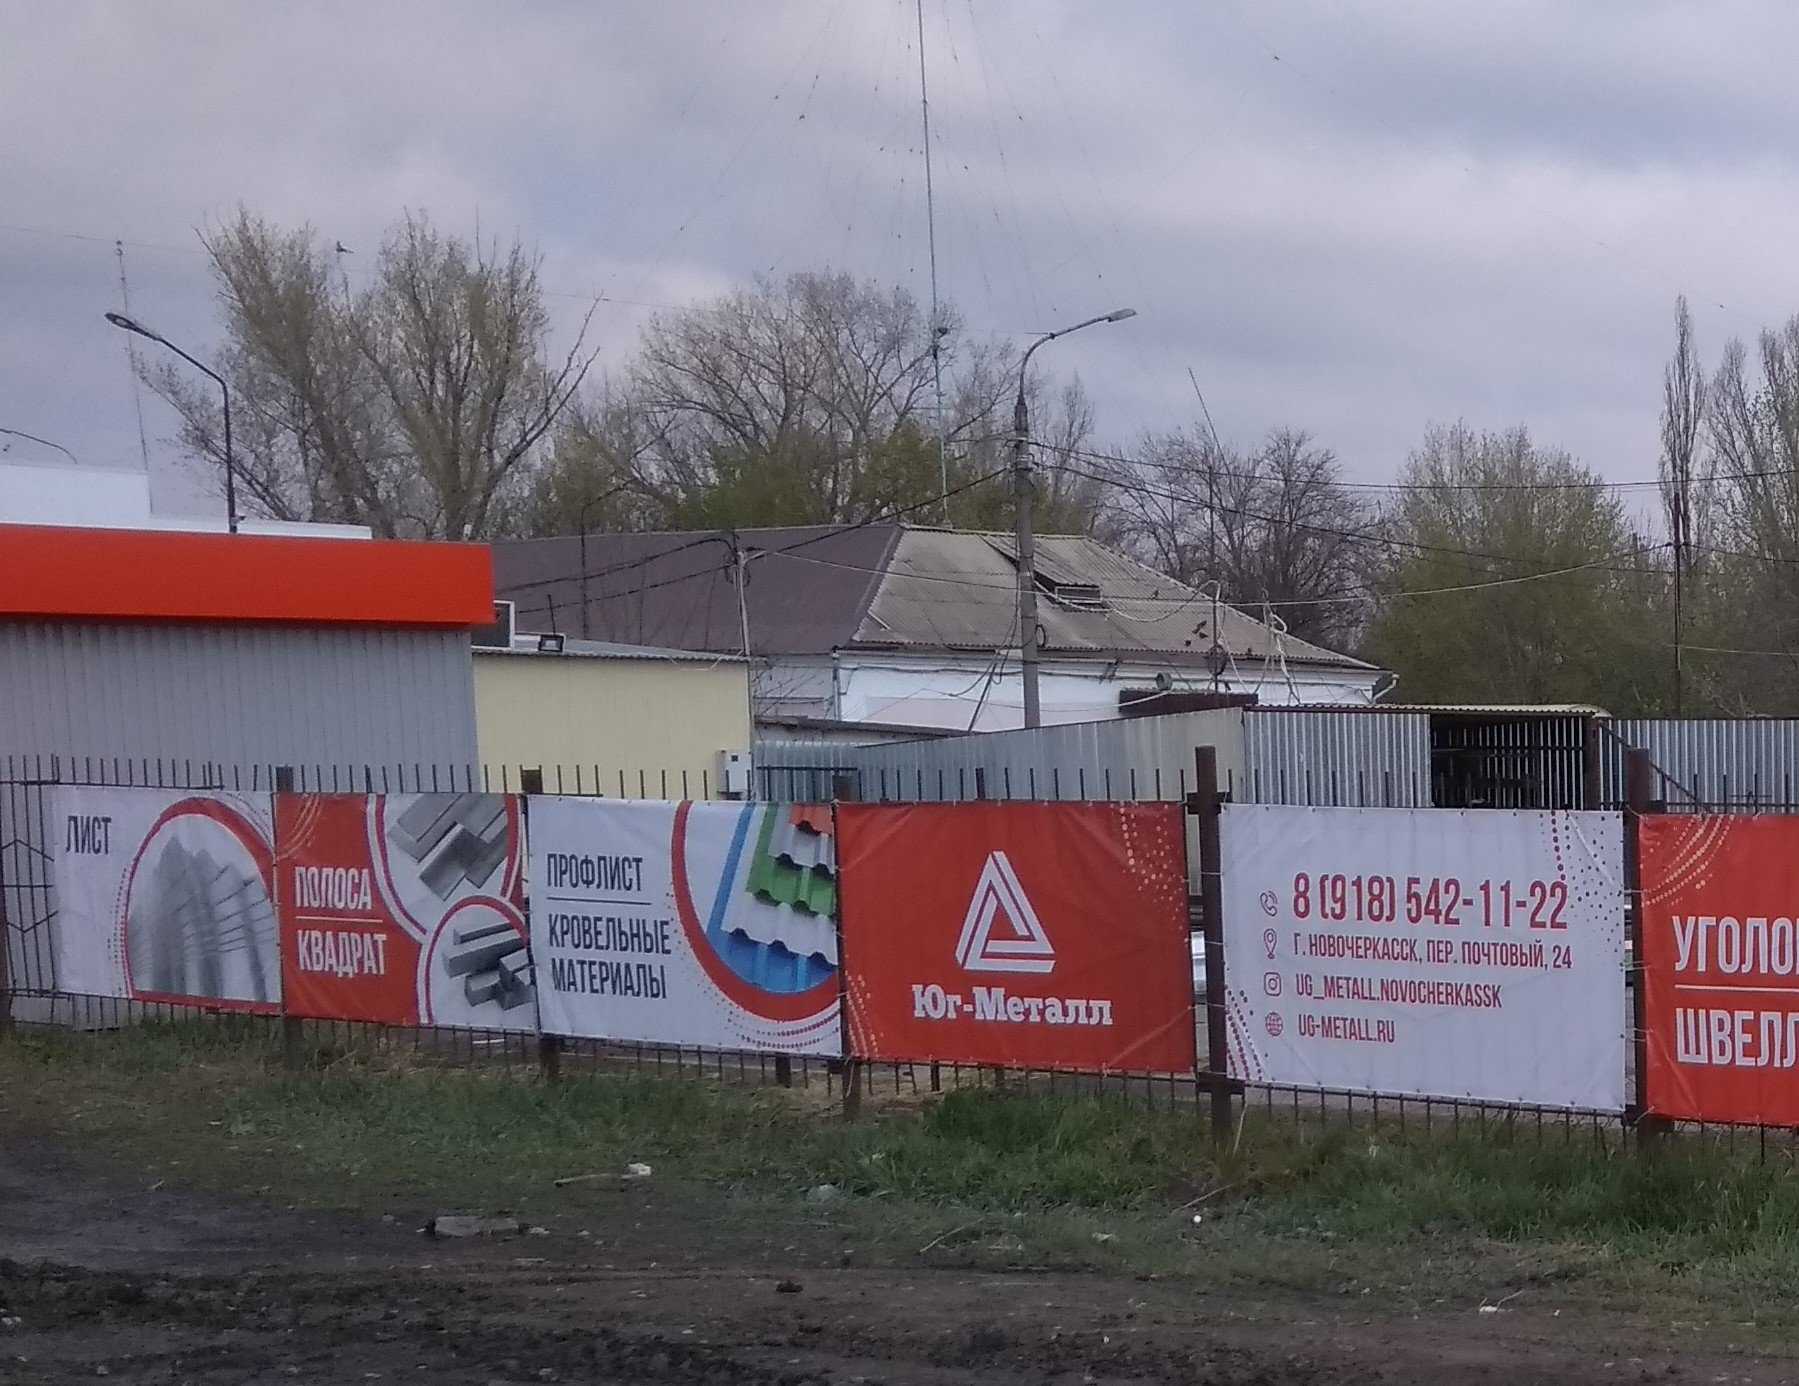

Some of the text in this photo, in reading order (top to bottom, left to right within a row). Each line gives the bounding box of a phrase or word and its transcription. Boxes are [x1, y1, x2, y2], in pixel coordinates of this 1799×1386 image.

[66, 815, 111, 855] ЛИСТ
[294, 866, 372, 910] ПОЛОСА
[546, 852, 643, 894] ПРОФЛИСТ
[1293, 872, 1569, 930] 8 (918) 542-11-22
[297, 929, 387, 978] КВАДРАТ
[547, 912, 672, 955] КРОВЕЛЬНЫЕ
[1294, 932, 1573, 971] Г. НОВОЧЕРКАССК, ПЕР. ПОЧТОВЫЙ, 24
[551, 957, 668, 999] МАТЕРИАЛЫ
[1295, 973, 1503, 1009] UG_METALL.NOVOCHERKASSK
[912, 984, 1113, 1026] Юг-Металл
[1298, 1013, 1396, 1045] UG-METALL.RU
